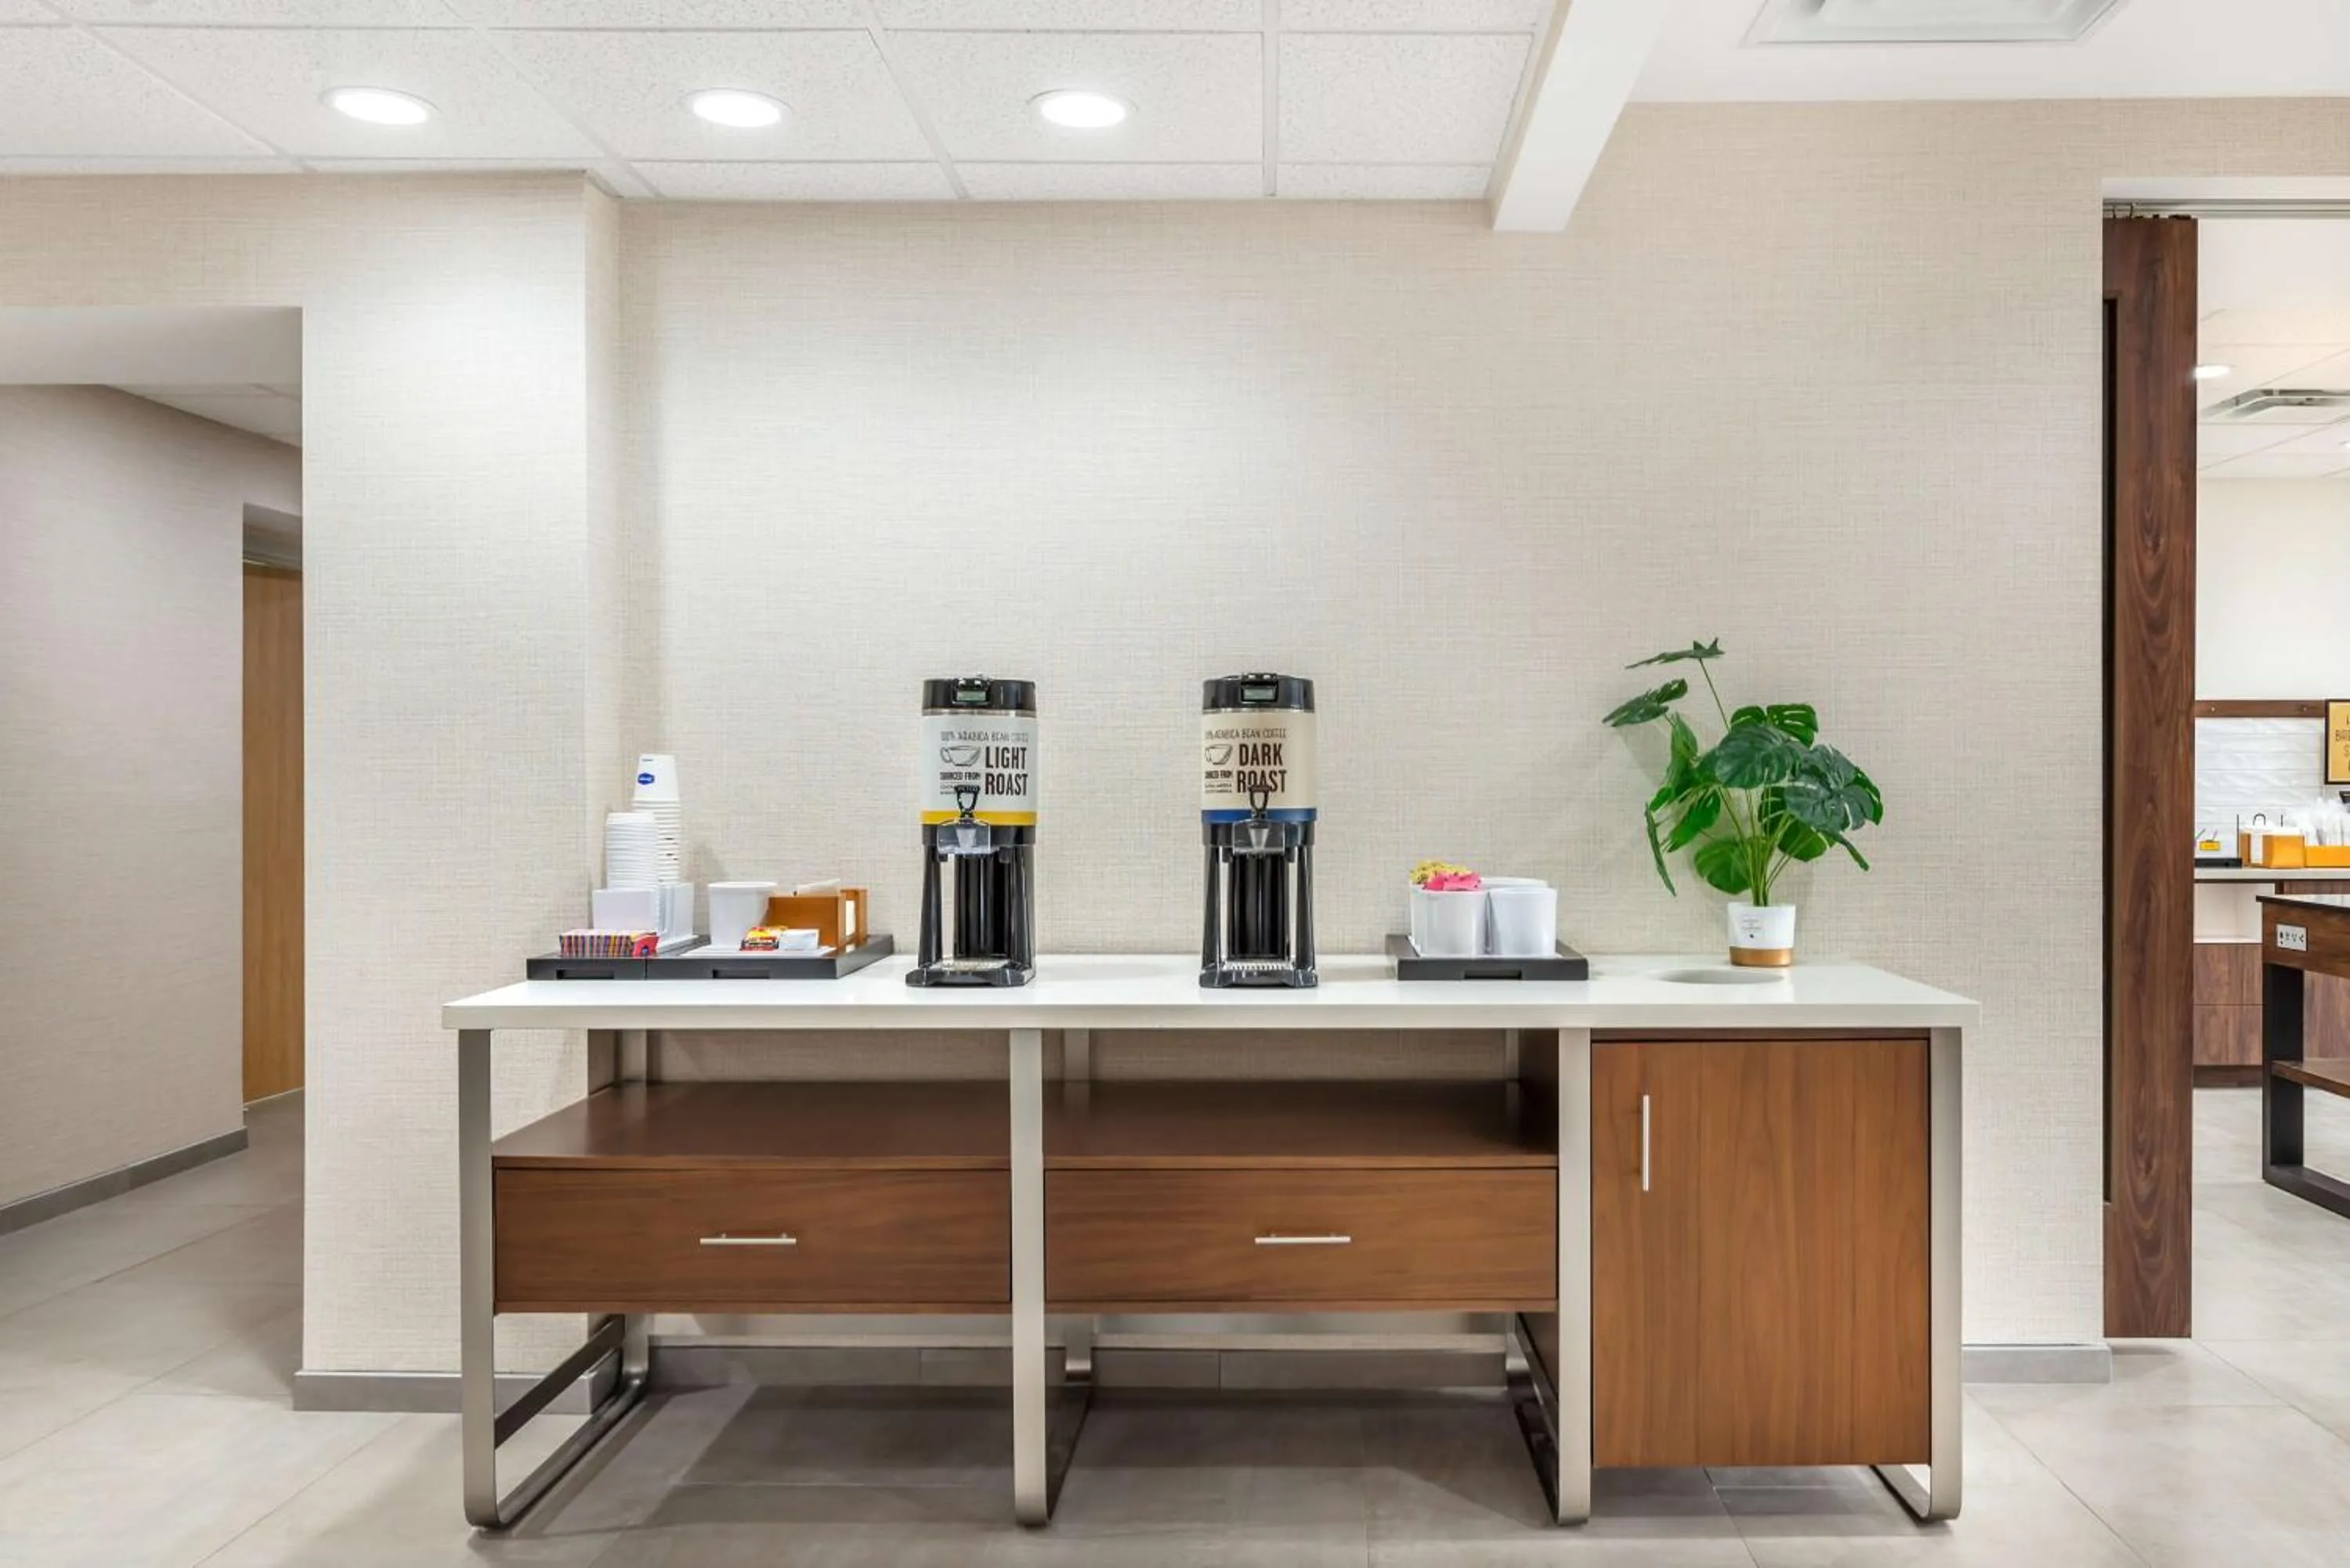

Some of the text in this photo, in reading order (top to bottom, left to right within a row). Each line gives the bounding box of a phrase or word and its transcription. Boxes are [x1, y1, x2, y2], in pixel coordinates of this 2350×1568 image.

[1241, 728, 1260, 739] BEAN
[985, 746, 1027, 769] LIGHT
[1239, 742, 1283, 767] DARK
[985, 772, 1028, 796] ROAST
[1236, 770, 1287, 793] ROAST
